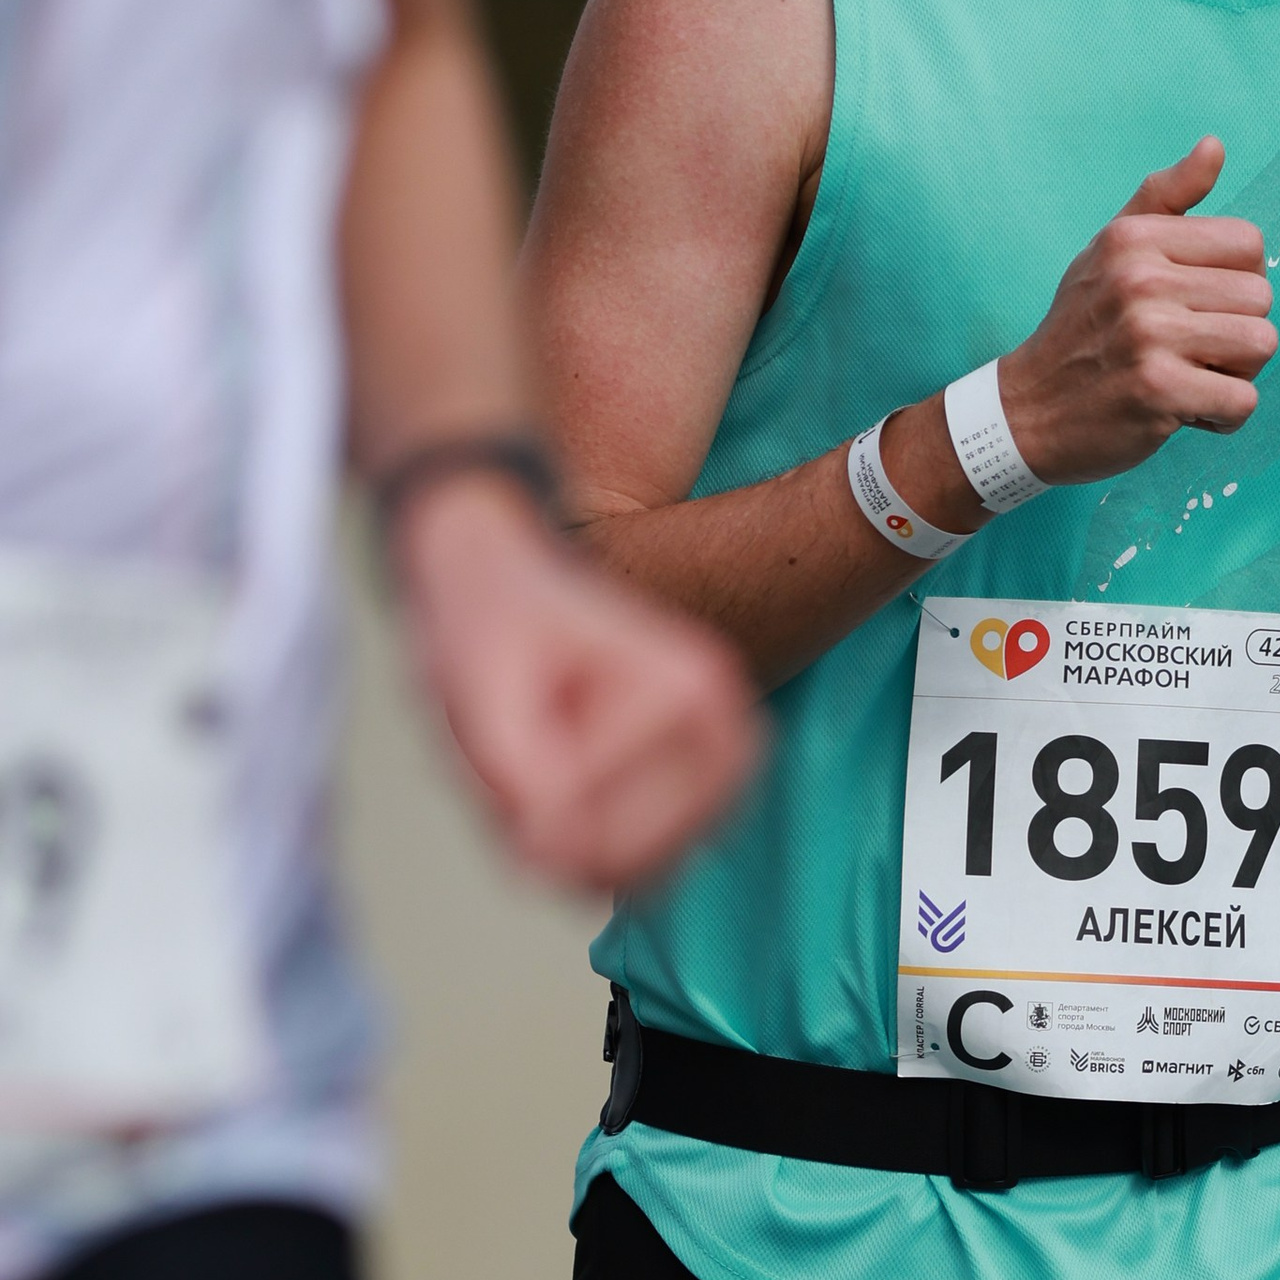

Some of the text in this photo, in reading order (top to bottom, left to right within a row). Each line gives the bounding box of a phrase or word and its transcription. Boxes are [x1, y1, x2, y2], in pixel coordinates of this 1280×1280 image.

[960, 427, 988, 446] 3:03:54
[965, 441, 994, 460] 2:40:55
[971, 455, 1000, 475] 2:17:55
[859, 452, 886, 512] МОСКОВСКИЙ
[866, 462, 892, 508] МАРАФОН
[1065, 620, 1191, 641] СБЕРПРАЙМ
[1064, 641, 1233, 668] МОСКОВСКИЙ
[1063, 665, 1190, 689] МАРАФОН
[1075, 904, 1247, 949] АЛЕКСЕЙ
[915, 986, 925, 1019] CORRAL
[1057, 1003, 1109, 1014] Департамент
[1057, 1014, 1085, 1022] спорта
[1163, 1006, 1226, 1023] МОСКОВСКИЙ
[1057, 1023, 1116, 1032] города Москвы
[1162, 1021, 1193, 1036] СПОРТ
[915, 1025, 925, 1059] КЛАСТЕР
[1090, 1063, 1125, 1074] BRICS
